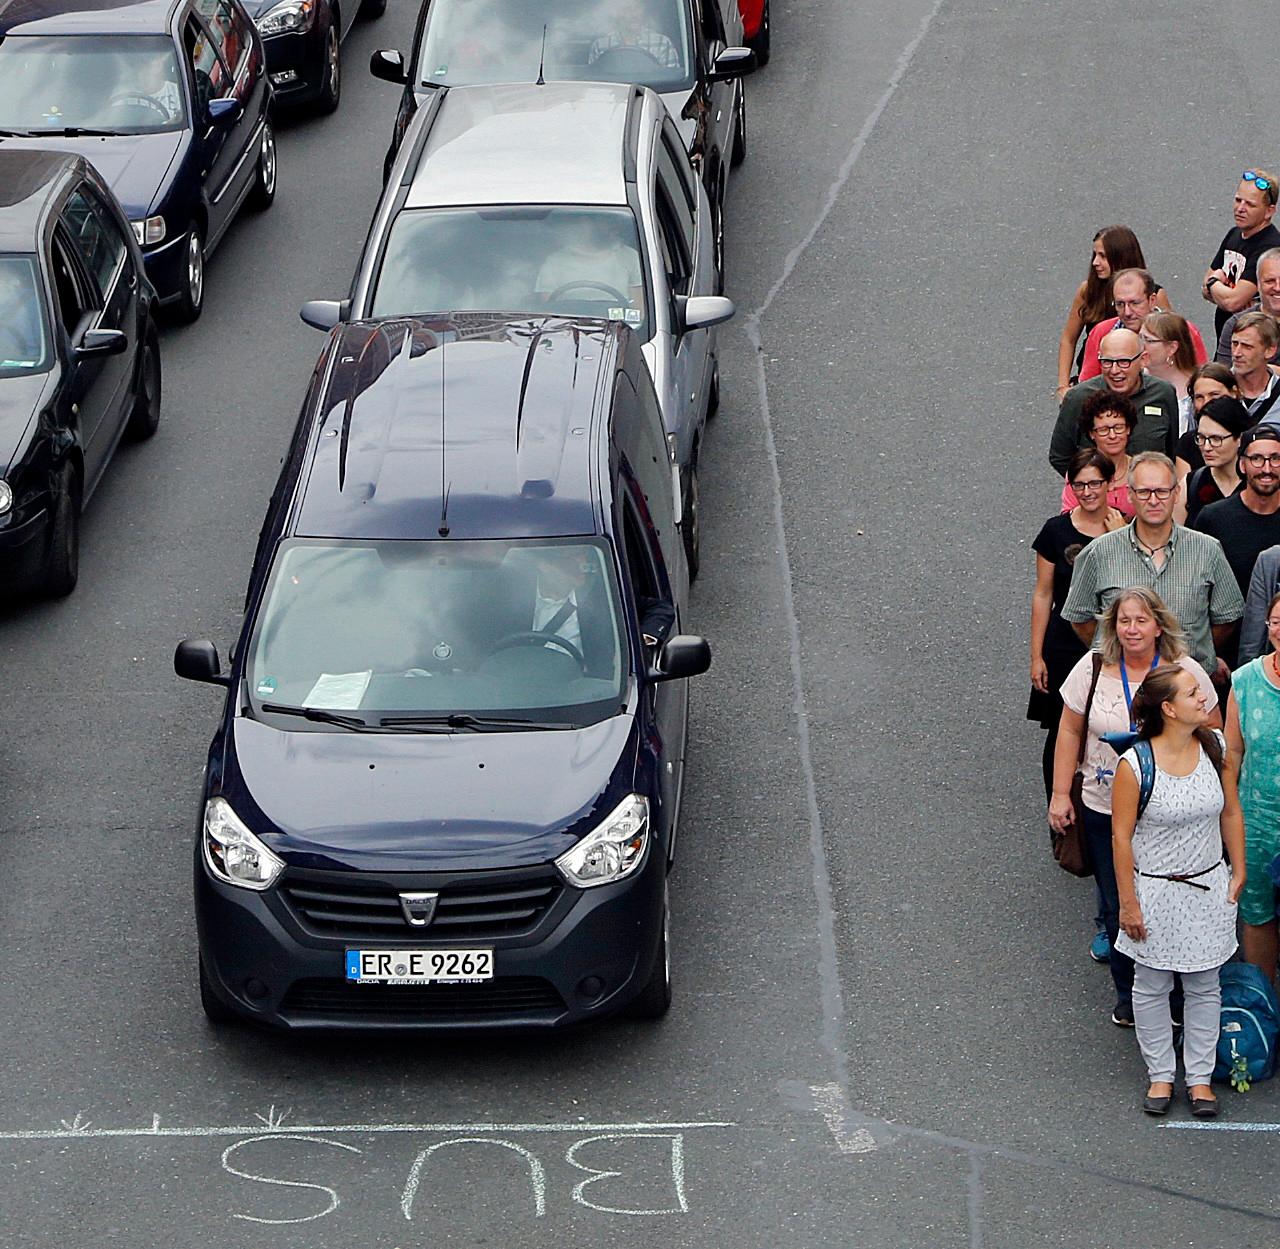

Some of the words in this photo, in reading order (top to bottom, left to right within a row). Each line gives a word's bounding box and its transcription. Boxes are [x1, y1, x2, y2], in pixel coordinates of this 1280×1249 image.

[362, 954, 392, 975] ER
[410, 954, 424, 975] E
[431, 953, 490, 975] 9262
[221, 1132, 688, 1225] BUS
